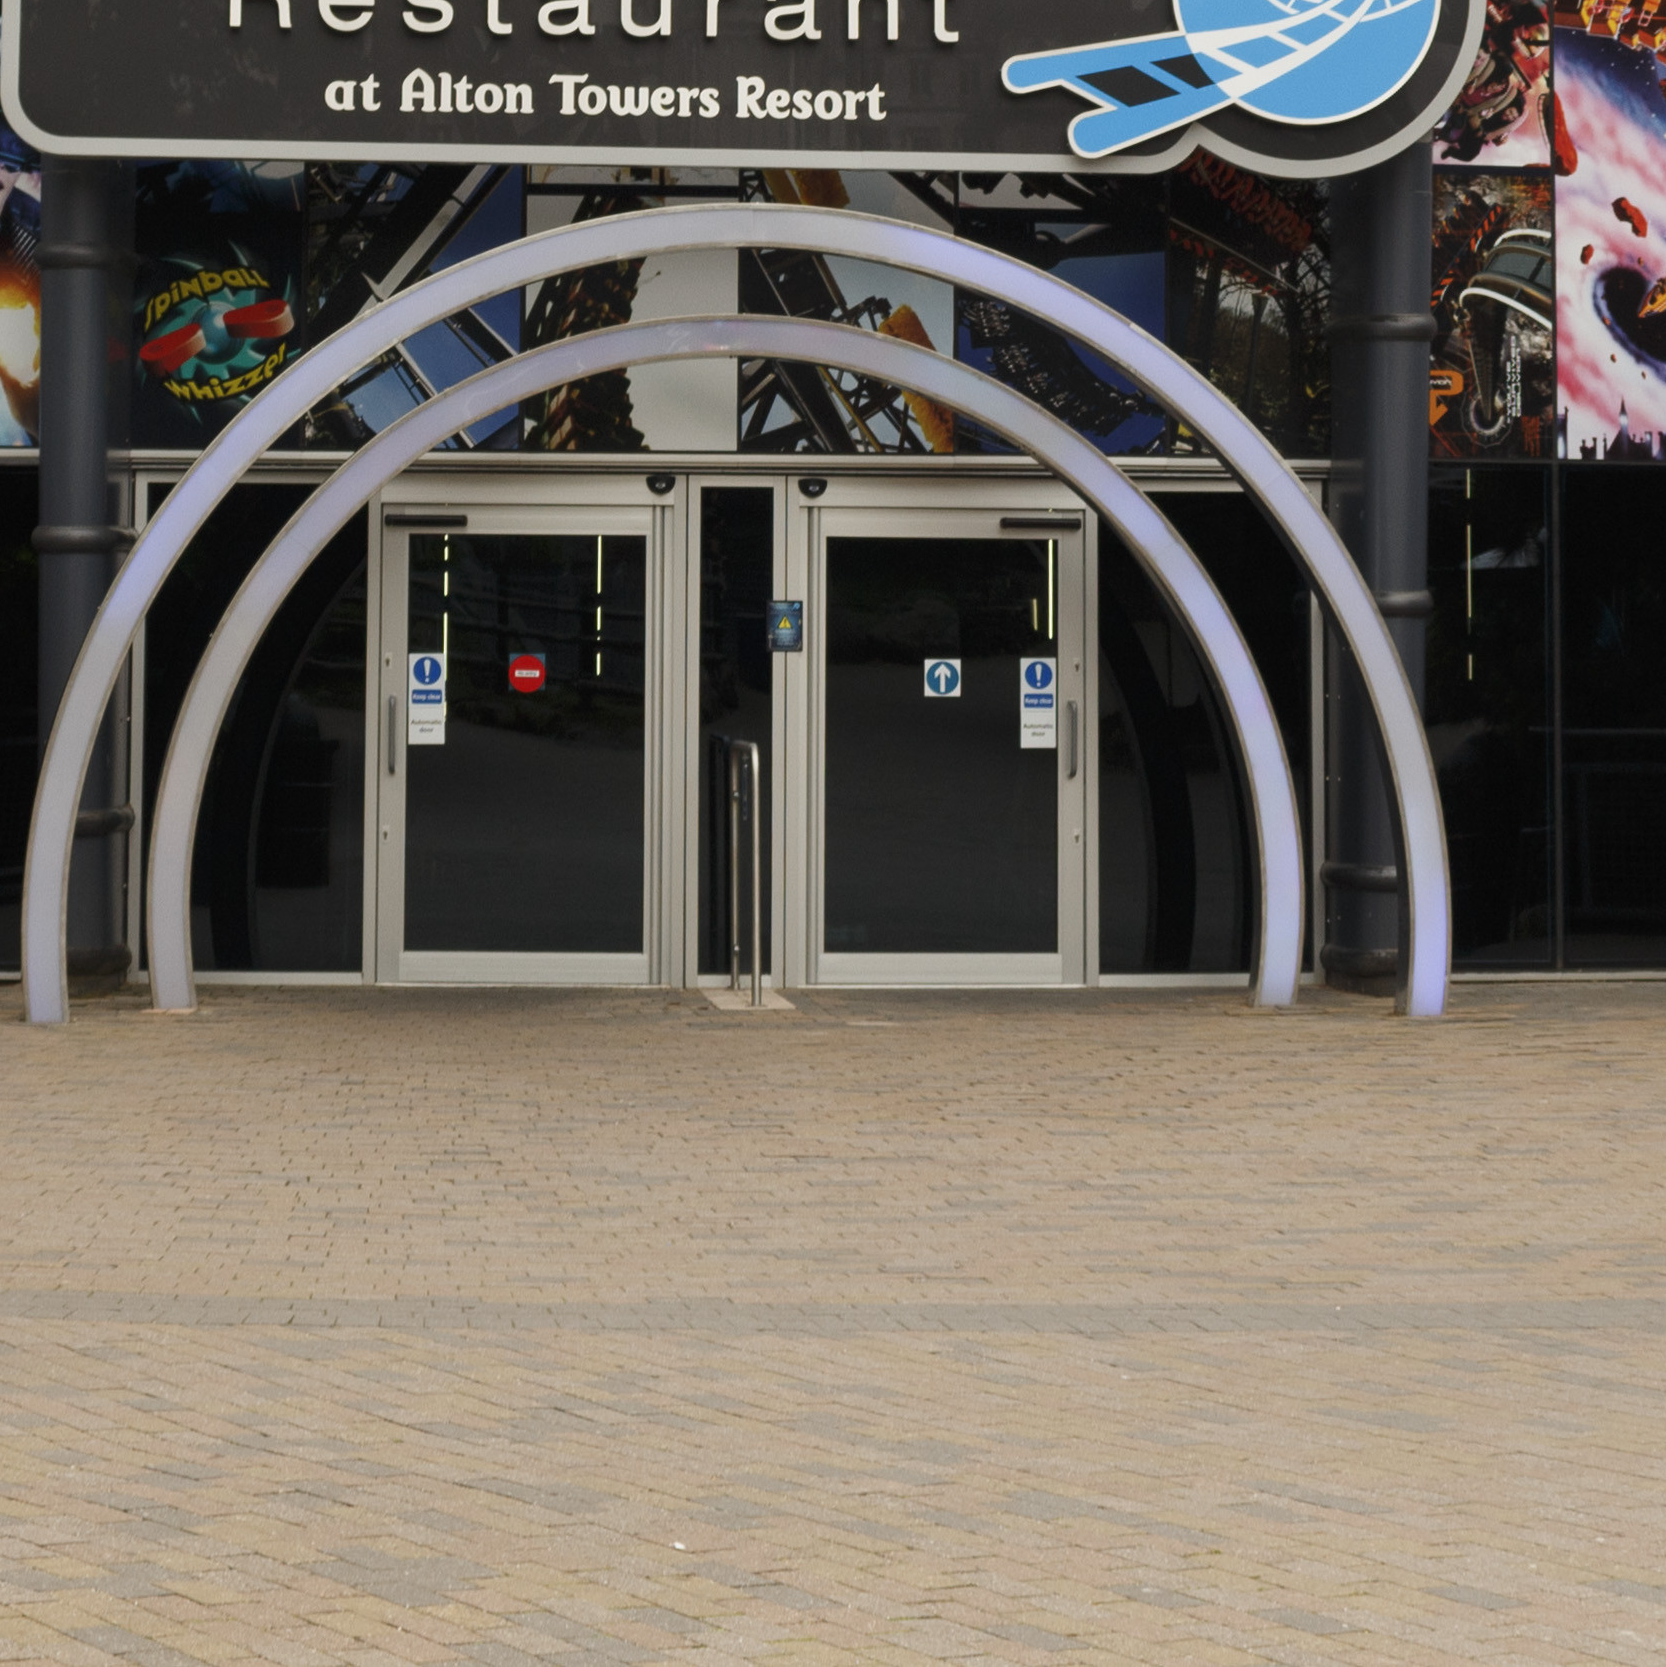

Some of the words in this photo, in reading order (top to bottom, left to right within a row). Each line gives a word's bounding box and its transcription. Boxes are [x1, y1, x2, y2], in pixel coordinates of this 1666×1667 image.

[324, 74, 381, 112] at
[399, 67, 535, 114] Alton
[549, 73, 721, 119] Towers
[736, 75, 887, 121] Resort
